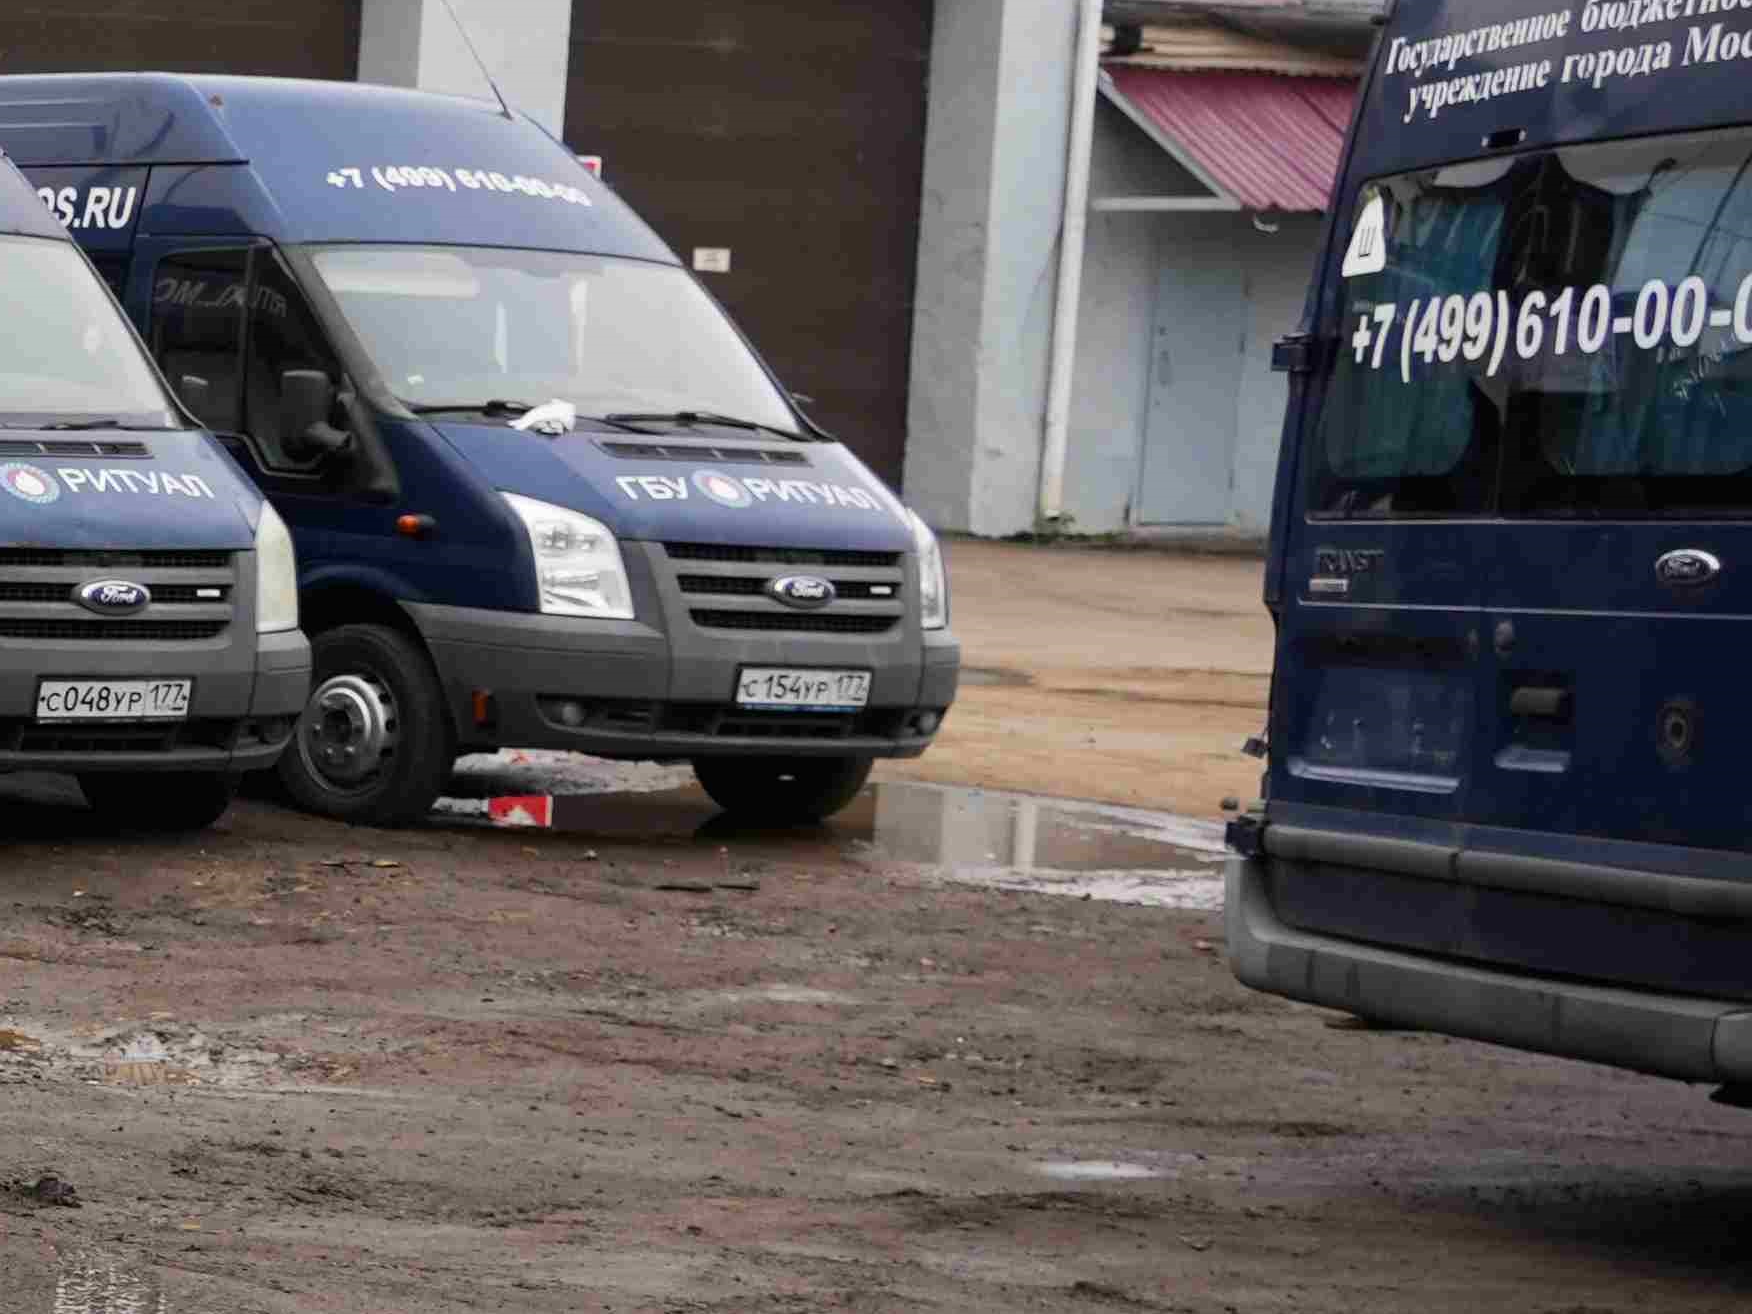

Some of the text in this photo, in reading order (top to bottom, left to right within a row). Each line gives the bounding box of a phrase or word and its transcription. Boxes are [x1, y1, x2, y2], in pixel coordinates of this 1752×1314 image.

[1384, 8, 1572, 78] Государственное
[1402, 59, 1552, 124] учреждение
[1560, 39, 1672, 89] города
[326, 167, 364, 189] +7
[371, 165, 456, 193] (499)
[1351, 301, 1397, 371] +7
[1400, 289, 1510, 384] (499)
[55, 467, 216, 499] РИТУАЛ
[615, 475, 884, 512] ГБУ РИТУАЛ
[100, 585, 138, 604] Ford
